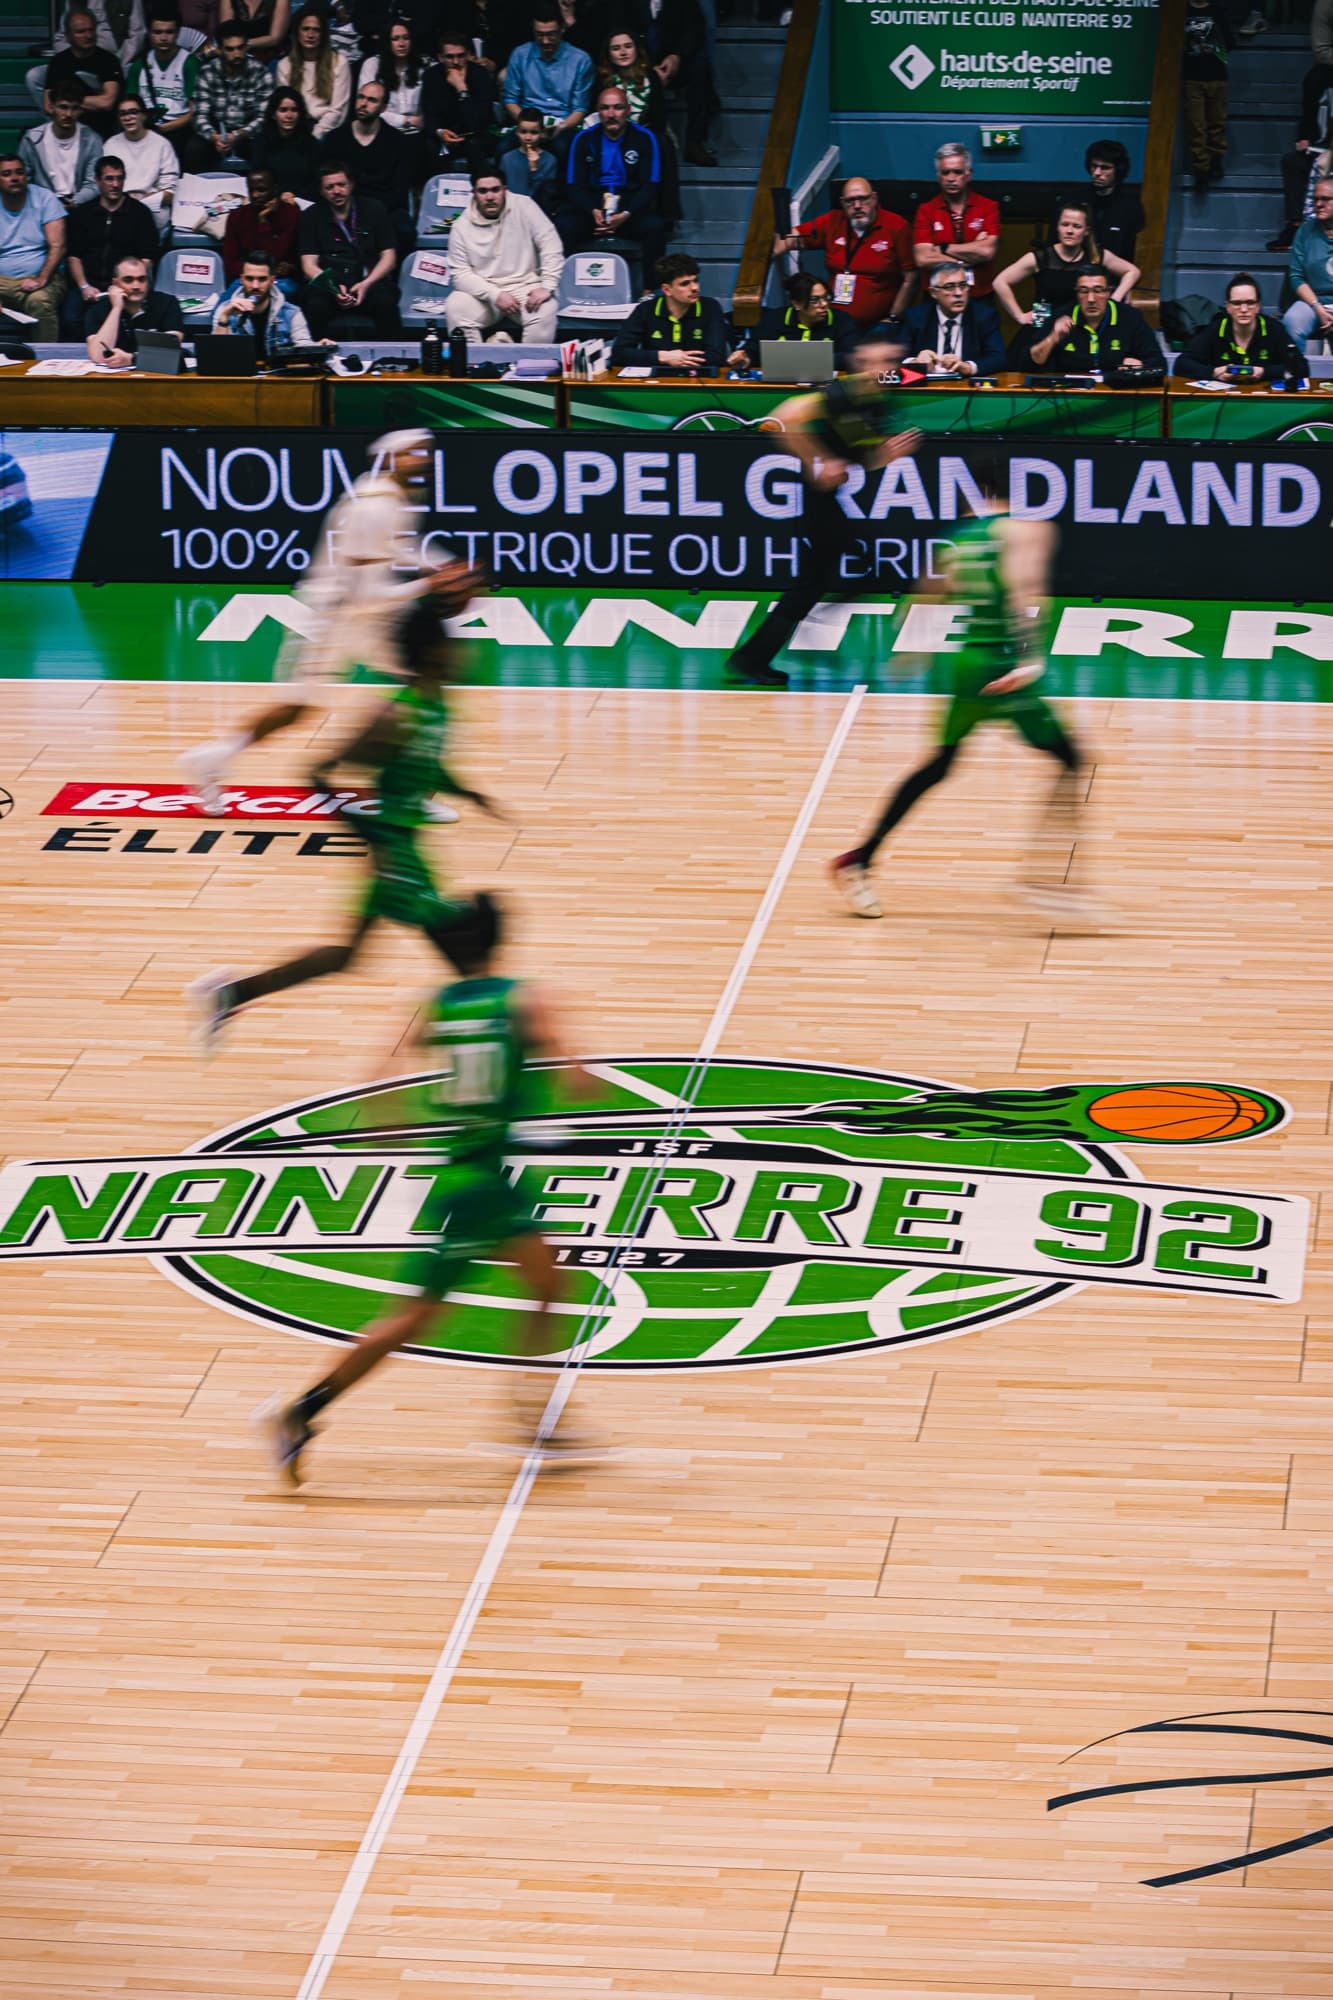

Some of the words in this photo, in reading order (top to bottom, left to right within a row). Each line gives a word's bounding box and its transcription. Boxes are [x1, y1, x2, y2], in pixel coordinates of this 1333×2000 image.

[870, 10, 949, 25] SOUTIENT
[952, 11, 972, 26] LE
[974, 11, 1016, 26] CLUB
[1022, 12, 1109, 28] NANTERRE
[1111, 14, 1132, 28] 92
[940, 49, 1112, 74] hauts-de-seine
[940, 75, 1029, 90] Département
[1032, 77, 1080, 92] Sportif
[493, 449, 724, 517] OPEL
[160, 528, 311, 570] 100%
[668, 533, 748, 577] OU
[41, 821, 372, 858] ÉLITE
[618, 1141, 714, 1155] JSF
[1033, 1189, 1271, 1285] 92
[555, 1250, 686, 1266] 1927
